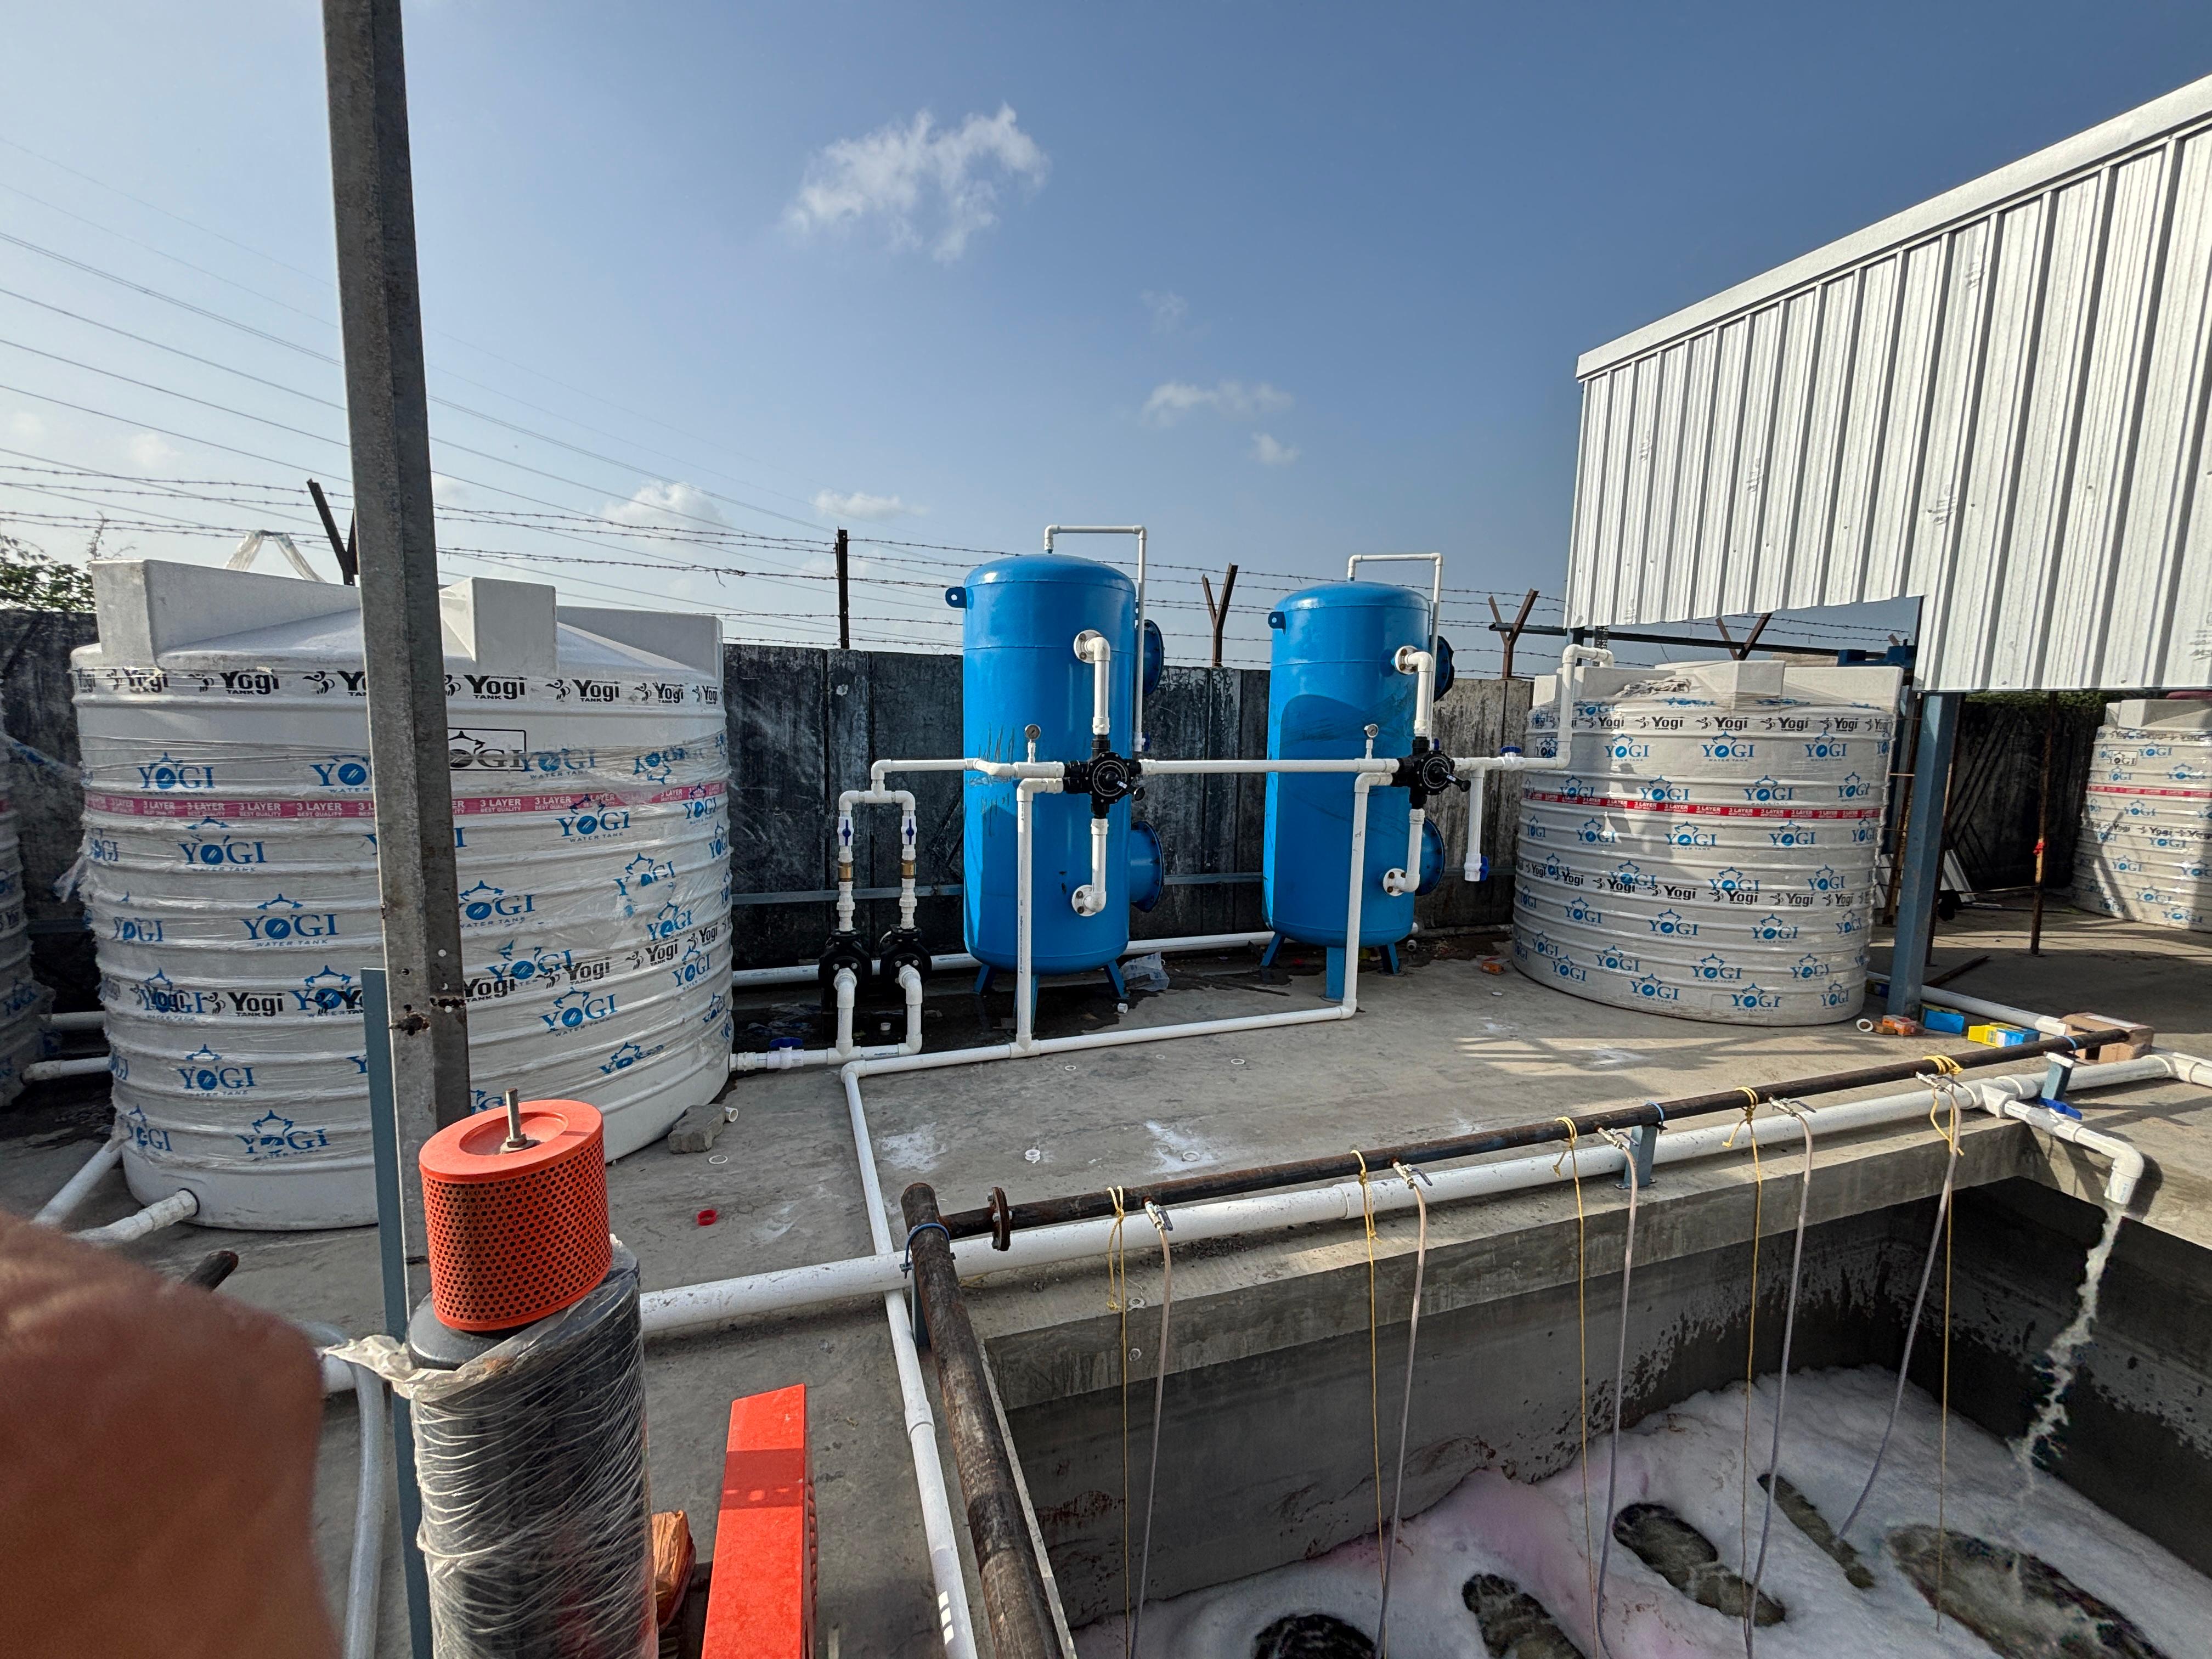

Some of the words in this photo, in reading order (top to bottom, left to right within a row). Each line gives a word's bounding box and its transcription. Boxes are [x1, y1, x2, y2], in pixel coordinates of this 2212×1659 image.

[219, 670, 279, 695] Yogi
[464, 675, 525, 699] Yogi
[572, 679, 619, 702] Yogi
[652, 682, 684, 704] Yogi
[702, 686, 718, 704] Yogi
[1598, 716, 1624, 727] Yogi
[1651, 716, 1683, 730] Yogi
[1713, 717, 1747, 731] Yogi
[1778, 718, 1809, 731] Yogi
[1833, 718, 1859, 731] Yogi
[1605, 744, 1649, 758] YOGI
[1701, 744, 1755, 758] YOGI
[1805, 743, 1848, 758] YOGI
[2138, 747, 2172, 757] YOGI
[137, 766, 216, 789] YOGI
[1560, 787, 1594, 798] YOGI
[1640, 788, 1690, 800] YOGI
[1743, 788, 1794, 801] YOGI
[1838, 783, 1870, 798] YOGI
[150, 802, 174, 810] LAYER
[682, 797, 716, 820] YOGI
[555, 811, 631, 837] YOGI
[2149, 827, 2171, 836] Yogi
[1577, 830, 1616, 843] YOGI
[1664, 833, 1717, 846] YOGI
[1769, 832, 1815, 846] YOGI
[1852, 827, 1875, 842] YOGI
[2149, 838, 2187, 848] YOGI
[178, 841, 267, 865] YOGI
[1532, 864, 1545, 878] Yogi
[2113, 862, 2142, 872] YOGI
[1562, 871, 1583, 886] Yogi
[1607, 879, 1635, 893] Yogi
[1610, 872, 1656, 886] YOGI
[1708, 879, 1760, 891] YOGI
[1808, 876, 1845, 890] YOGI
[1663, 885, 1696, 900] Yogi
[1727, 891, 1758, 905] Yogi
[1786, 893, 1813, 907] Yogi
[1835, 894, 1853, 906] Yogi
[2136, 891, 2173, 904] YOGI
[1564, 906, 1602, 924] YOGI
[2163, 911, 2203, 923] YOGI
[240, 914, 340, 940] YOGI
[647, 910, 692, 941] YOGI
[1648, 920, 1699, 935] YOGI
[1751, 927, 1798, 939] YOGI
[1836, 917, 1862, 934] YOGI
[699, 926, 718, 944] Yogi
[645, 943, 678, 962] Yogi
[1532, 938, 1558, 956] YOGI
[485, 949, 574, 982] YOGI
[672, 953, 711, 987] YOGI
[1553, 961, 1587, 981] YOGI
[1595, 955, 1640, 972] YOGI
[562, 962, 610, 981] Yogi
[1690, 966, 1743, 979] YOGI
[1791, 964, 1830, 979] YOGI
[464, 978, 516, 998] Yogi
[1630, 981, 1680, 1000] YOGI
[228, 992, 283, 1017] Yogi
[1731, 994, 1782, 1008] YOGI
[1821, 990, 1849, 1006] YOGI
[540, 994, 619, 1034] YOGI
[555, 1025, 585, 1037] WATER
[177, 1066, 257, 1090] YOGI
[236, 1128, 331, 1154] YOGI
